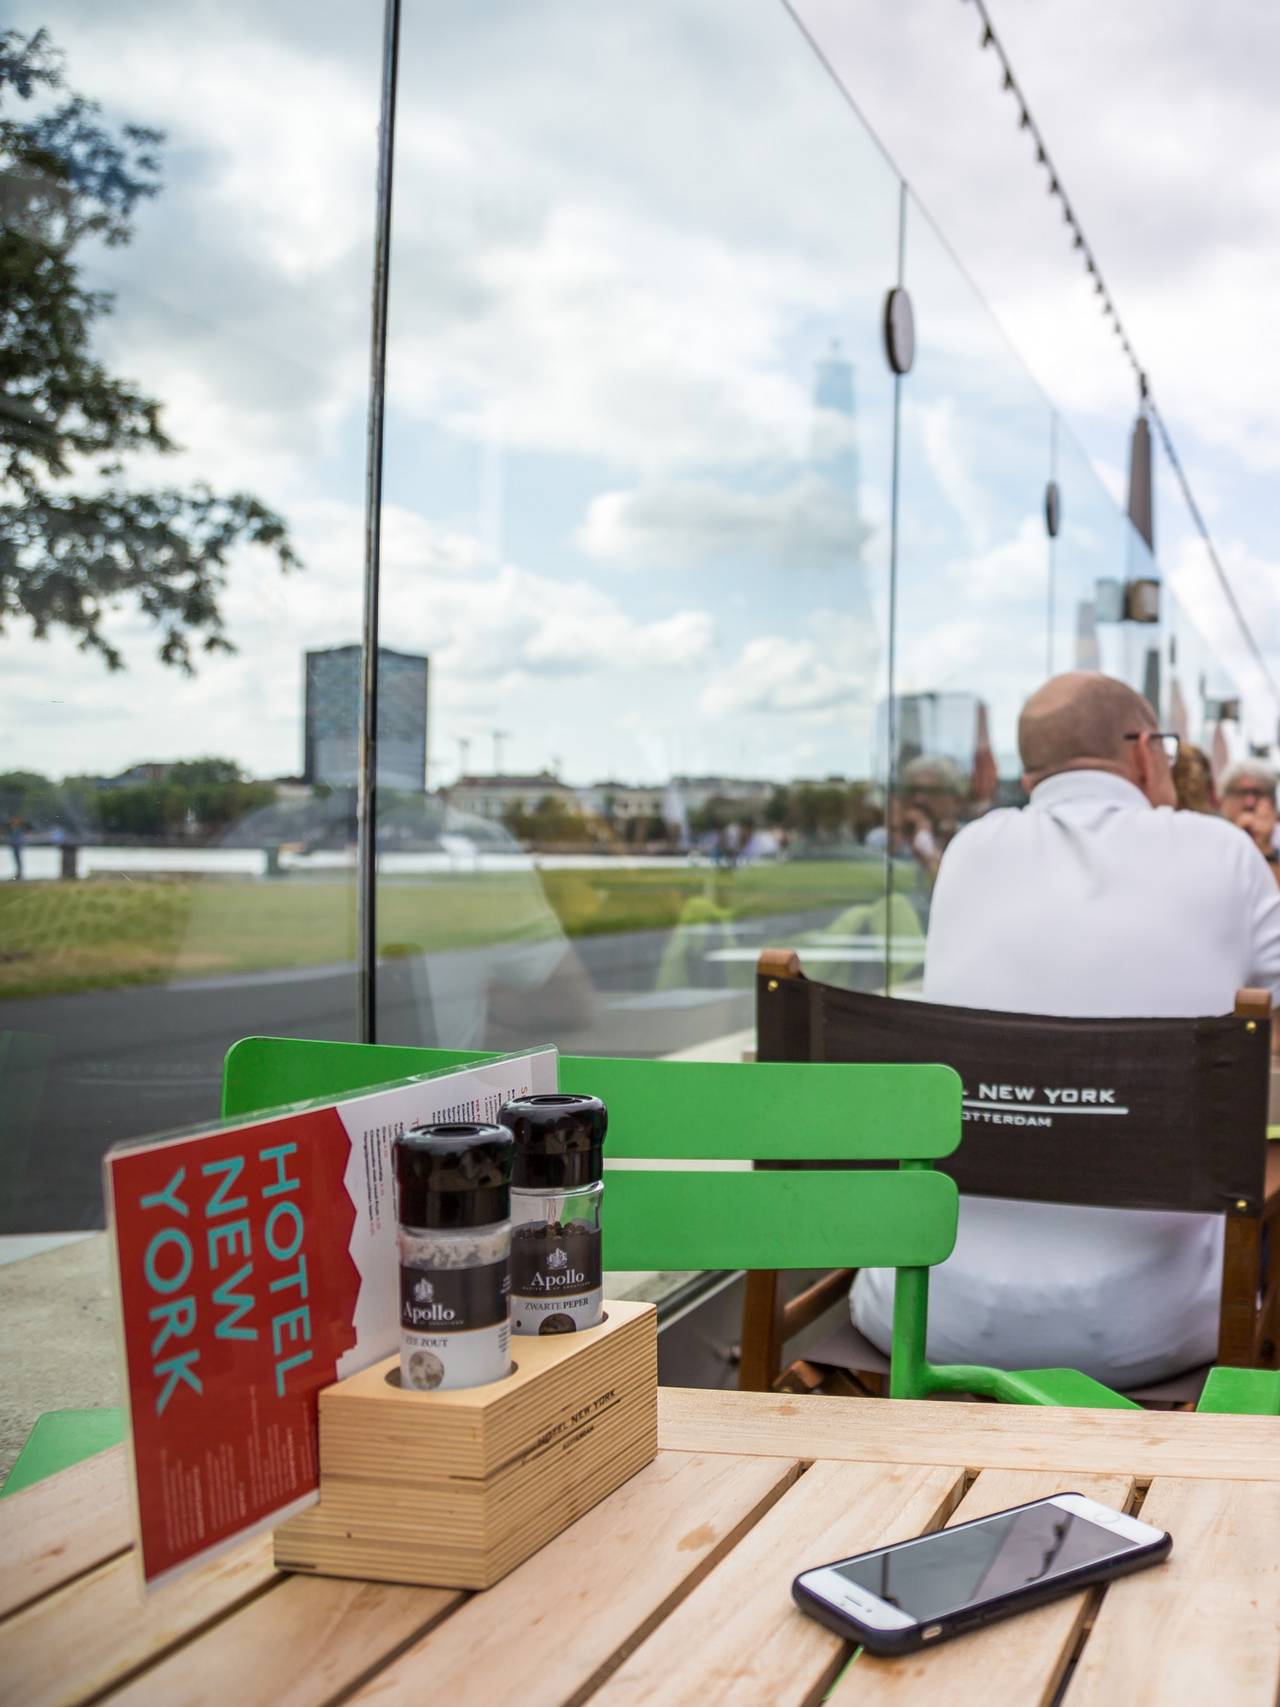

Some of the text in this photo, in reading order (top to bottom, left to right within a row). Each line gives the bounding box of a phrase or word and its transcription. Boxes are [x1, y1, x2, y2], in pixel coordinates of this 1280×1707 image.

[979, 1083, 1034, 1101] NEW
[1044, 1088, 1116, 1104] YORK
[962, 1111, 1052, 1128] OTTERDAM
[203, 1156, 258, 1341] NEW
[262, 1143, 313, 1397] HOTEL
[530, 1268, 585, 1291] Apollo
[140, 1168, 201, 1414] YORK
[403, 1301, 456, 1324] Apollo
[524, 1297, 589, 1311] ZWARTE PEPER
[570, 1406, 592, 1424] NEW
[593, 1389, 616, 1408] YORK
